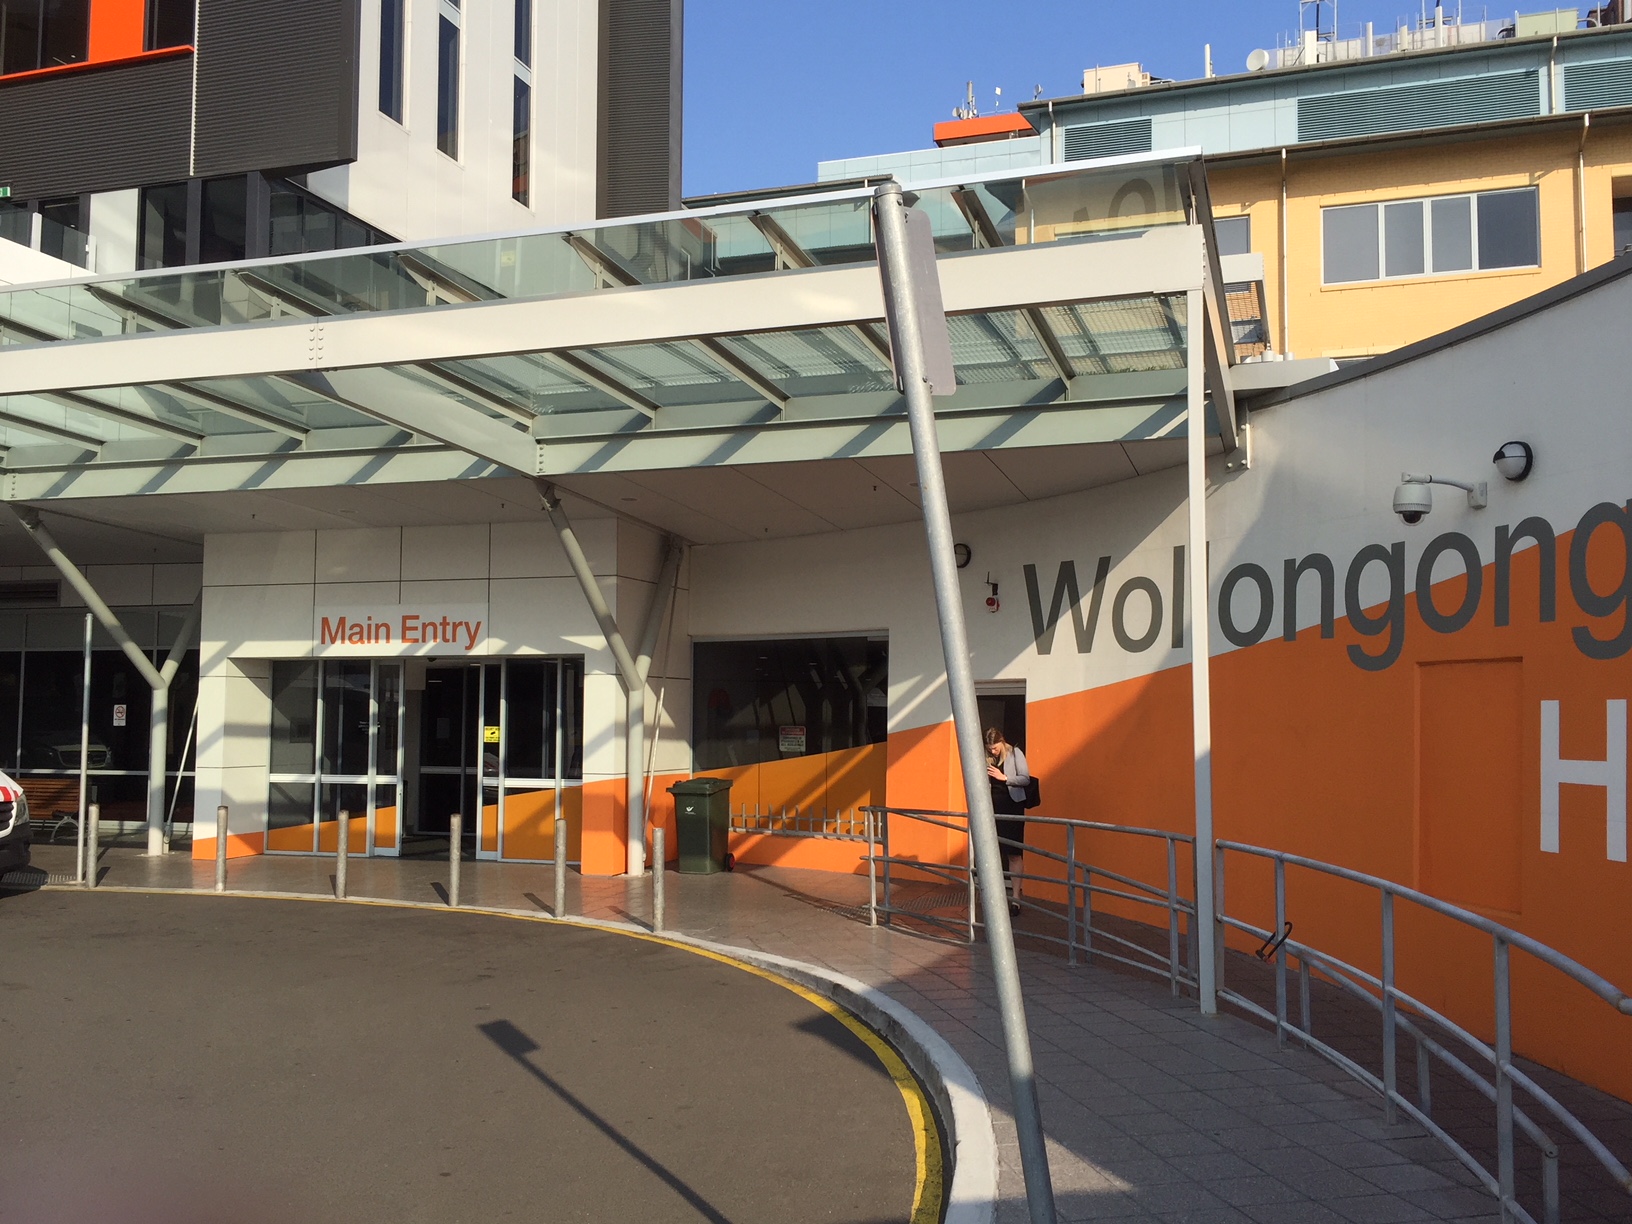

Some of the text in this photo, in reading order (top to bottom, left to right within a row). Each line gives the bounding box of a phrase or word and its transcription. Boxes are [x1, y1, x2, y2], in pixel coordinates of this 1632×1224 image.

[321, 614, 482, 651] Main Entry
[1023, 498, 1632, 671] Wolongong
[1540, 699, 1627, 862] H
